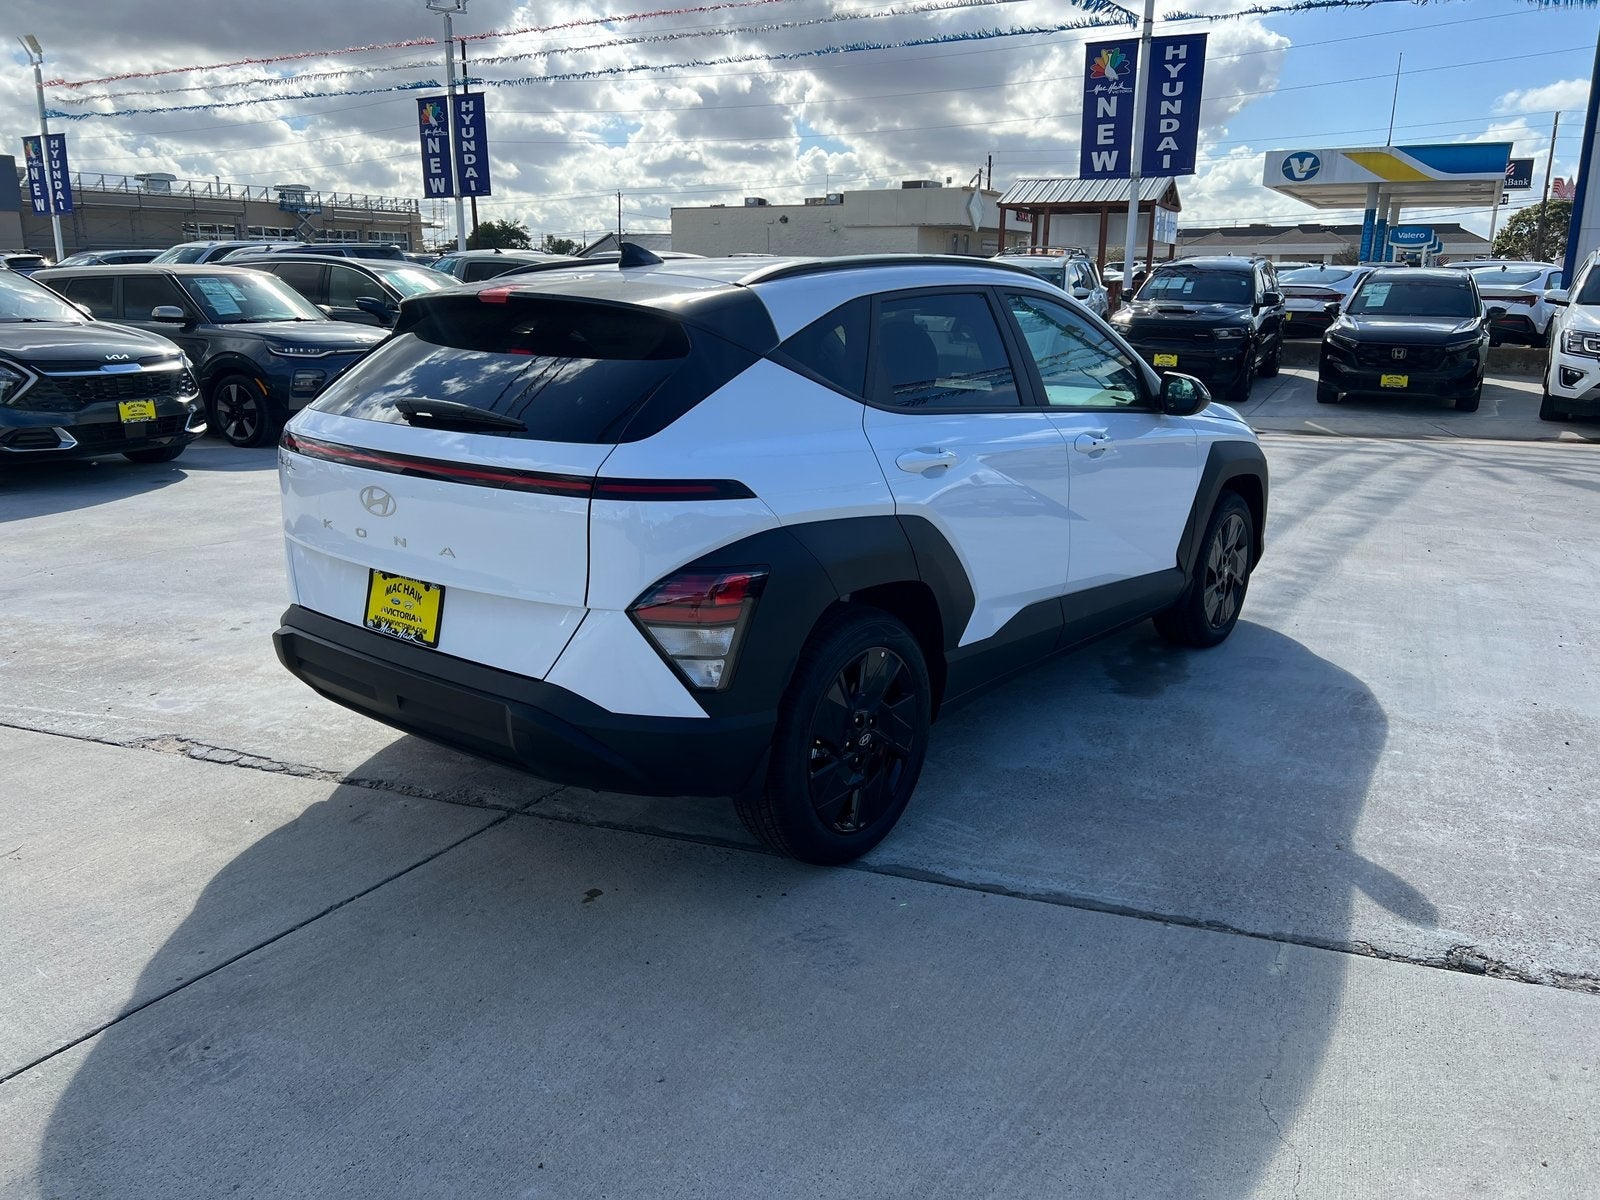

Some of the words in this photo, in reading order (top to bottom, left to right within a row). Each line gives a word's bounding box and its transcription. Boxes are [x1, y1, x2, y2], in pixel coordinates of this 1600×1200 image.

[1156, 44, 1187, 169] HYUNDAI
[461, 100, 478, 191] HYUNDAI
[1091, 96, 1119, 172] NEW
[30, 167, 45, 212] NEW
[50, 139, 65, 210] HYUNDAI
[427, 137, 446, 193] NEW
[1397, 231, 1426, 239] Valero
[323, 518, 457, 559] KONA
[384, 582, 402, 597] MAC
[403, 585, 423, 606] HAIK
[386, 606, 416, 622] VICTORIA
